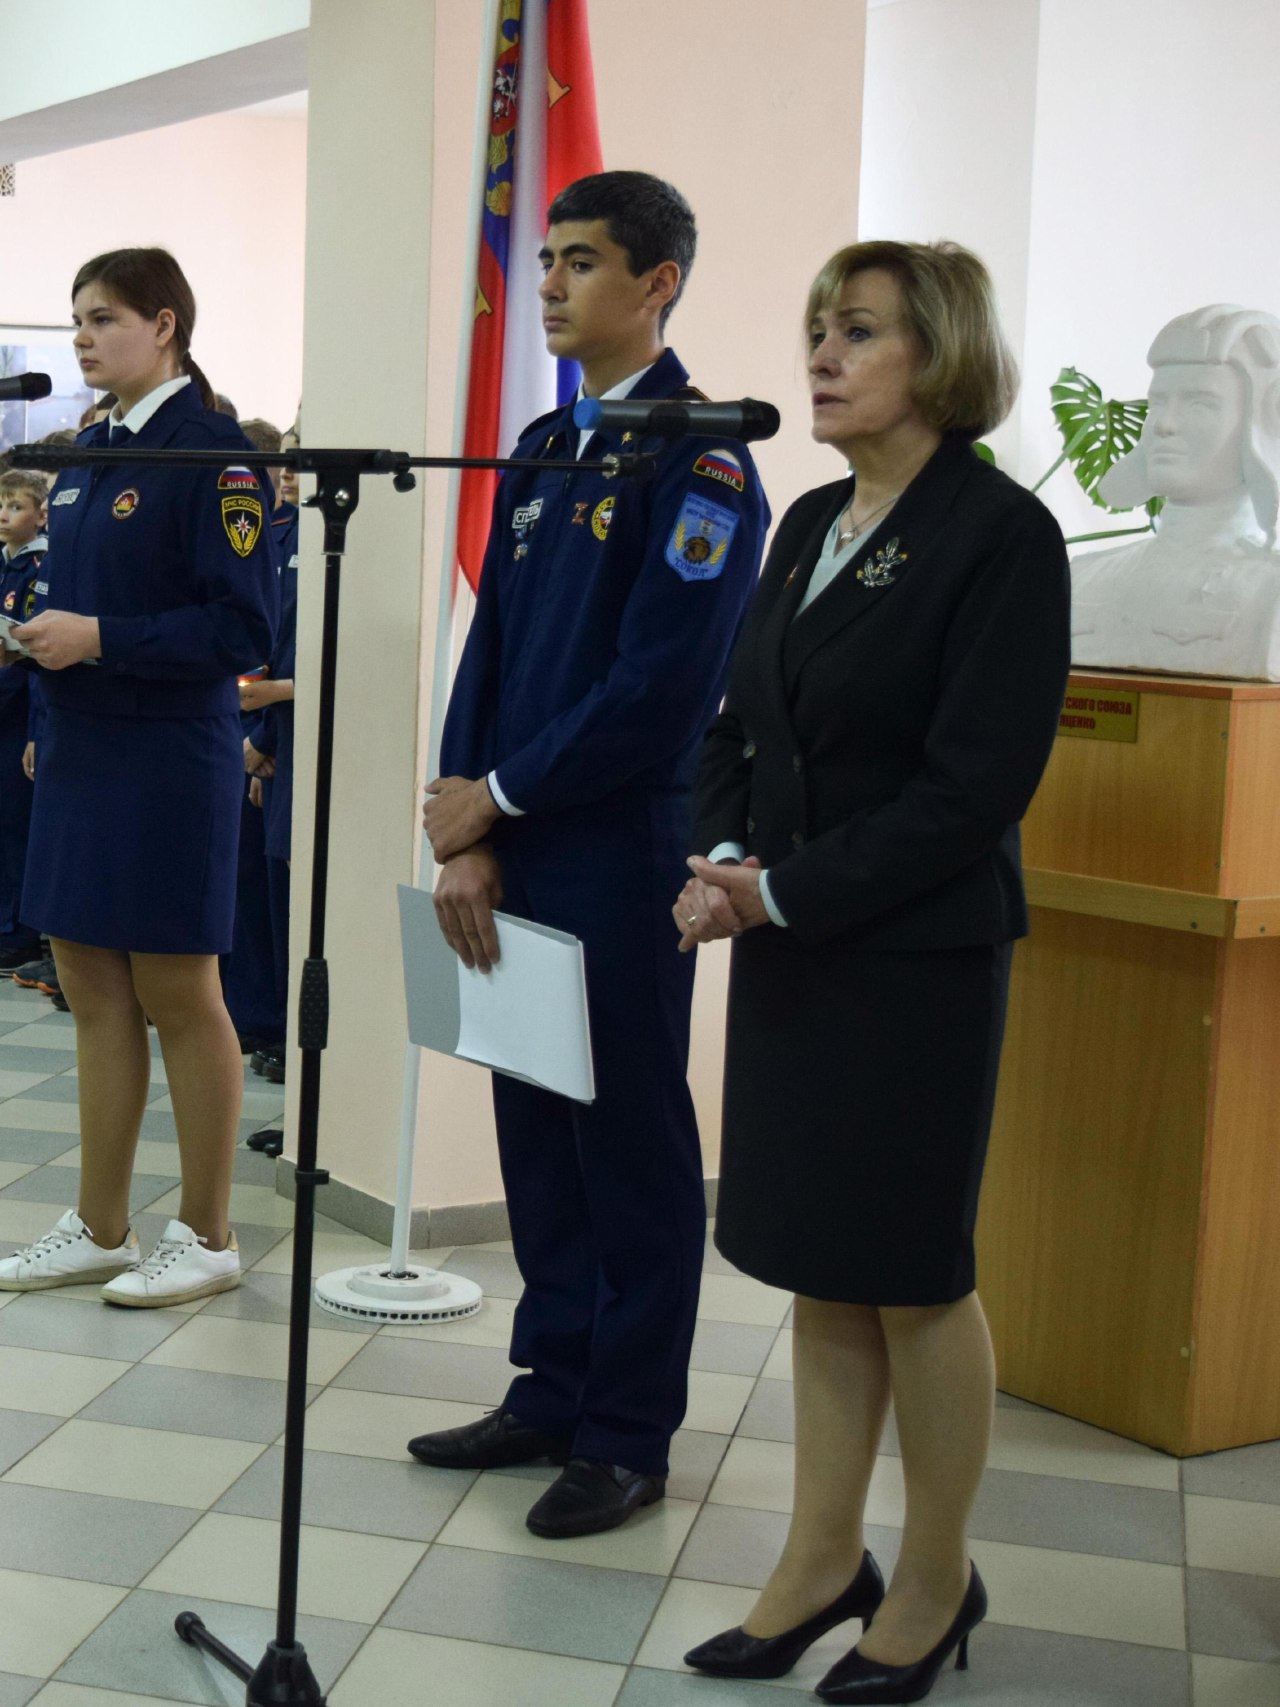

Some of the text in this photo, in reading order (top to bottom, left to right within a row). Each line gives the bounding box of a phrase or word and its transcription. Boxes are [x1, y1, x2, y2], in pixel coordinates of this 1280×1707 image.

[705, 466, 737, 487] RUSSIA
[1065, 697, 1132, 715] СКОГО СОЮЗА
